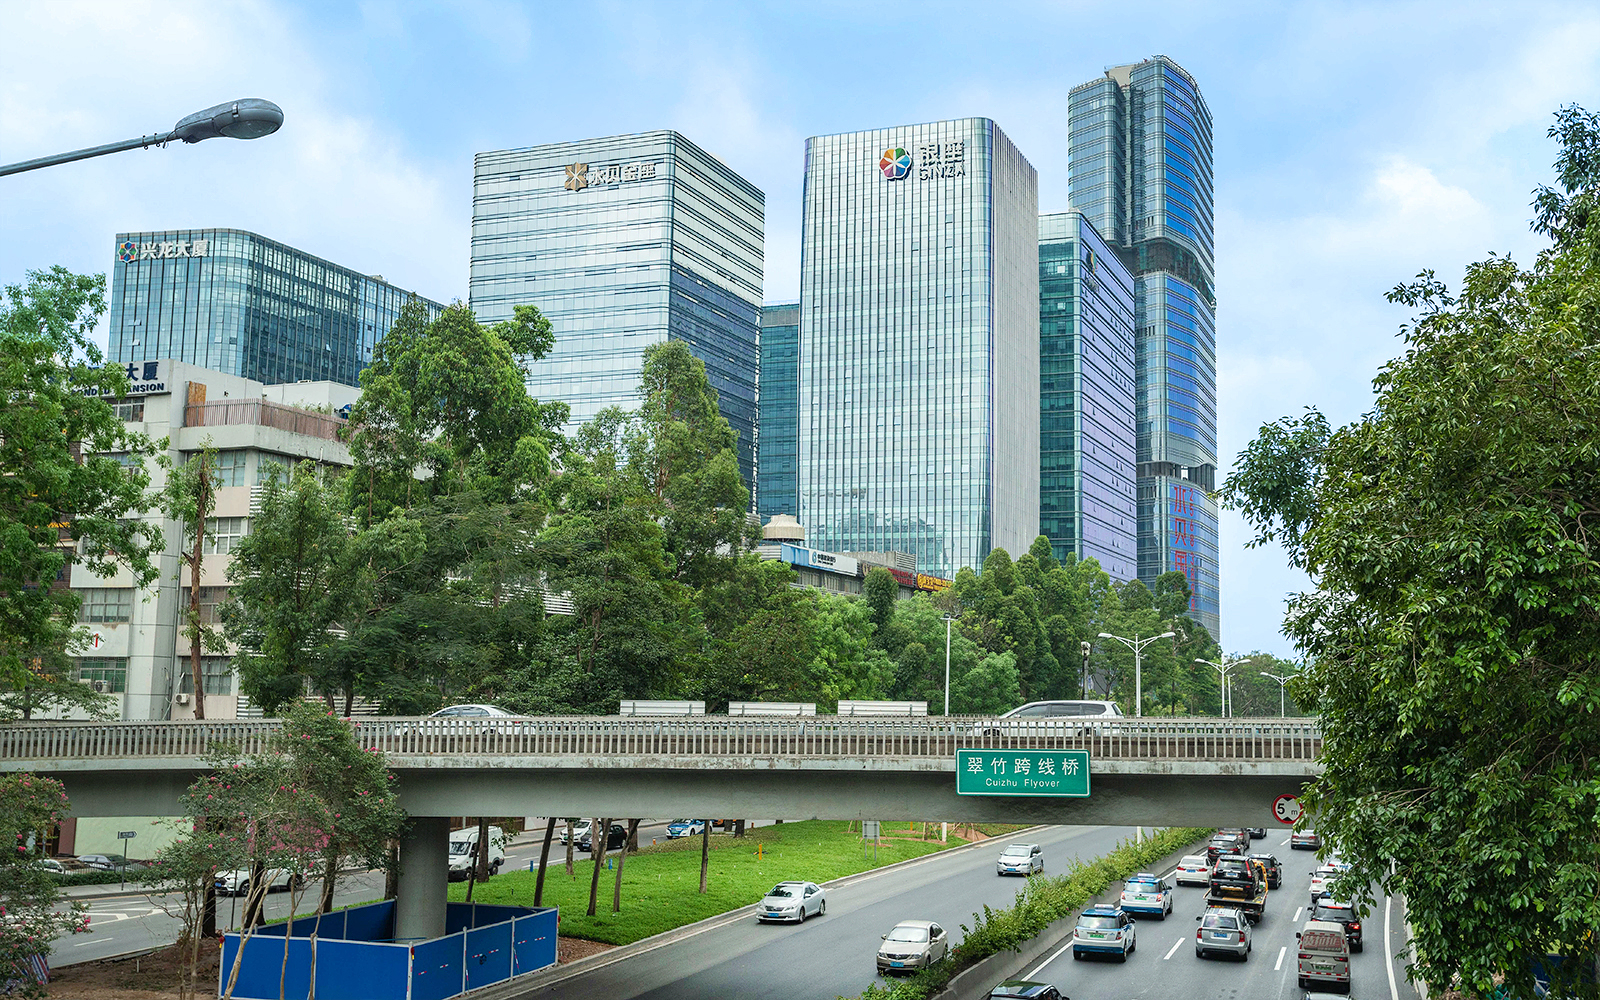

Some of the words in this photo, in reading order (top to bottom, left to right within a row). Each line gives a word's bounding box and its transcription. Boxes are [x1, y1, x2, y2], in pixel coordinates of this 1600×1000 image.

[919, 139, 965, 166] 银座
[919, 163, 966, 181] SINZA
[140, 239, 210, 260] 兴龙大厦
[126, 382, 165, 394] ANSION
[1174, 485, 1188, 594] 水贝国
[966, 757, 1080, 776] 翠竹跨线桥
[985, 777, 1018, 787] Cuizhu
[1024, 778, 1060, 789] Flyover
[1277, 803, 1286, 815] 5
